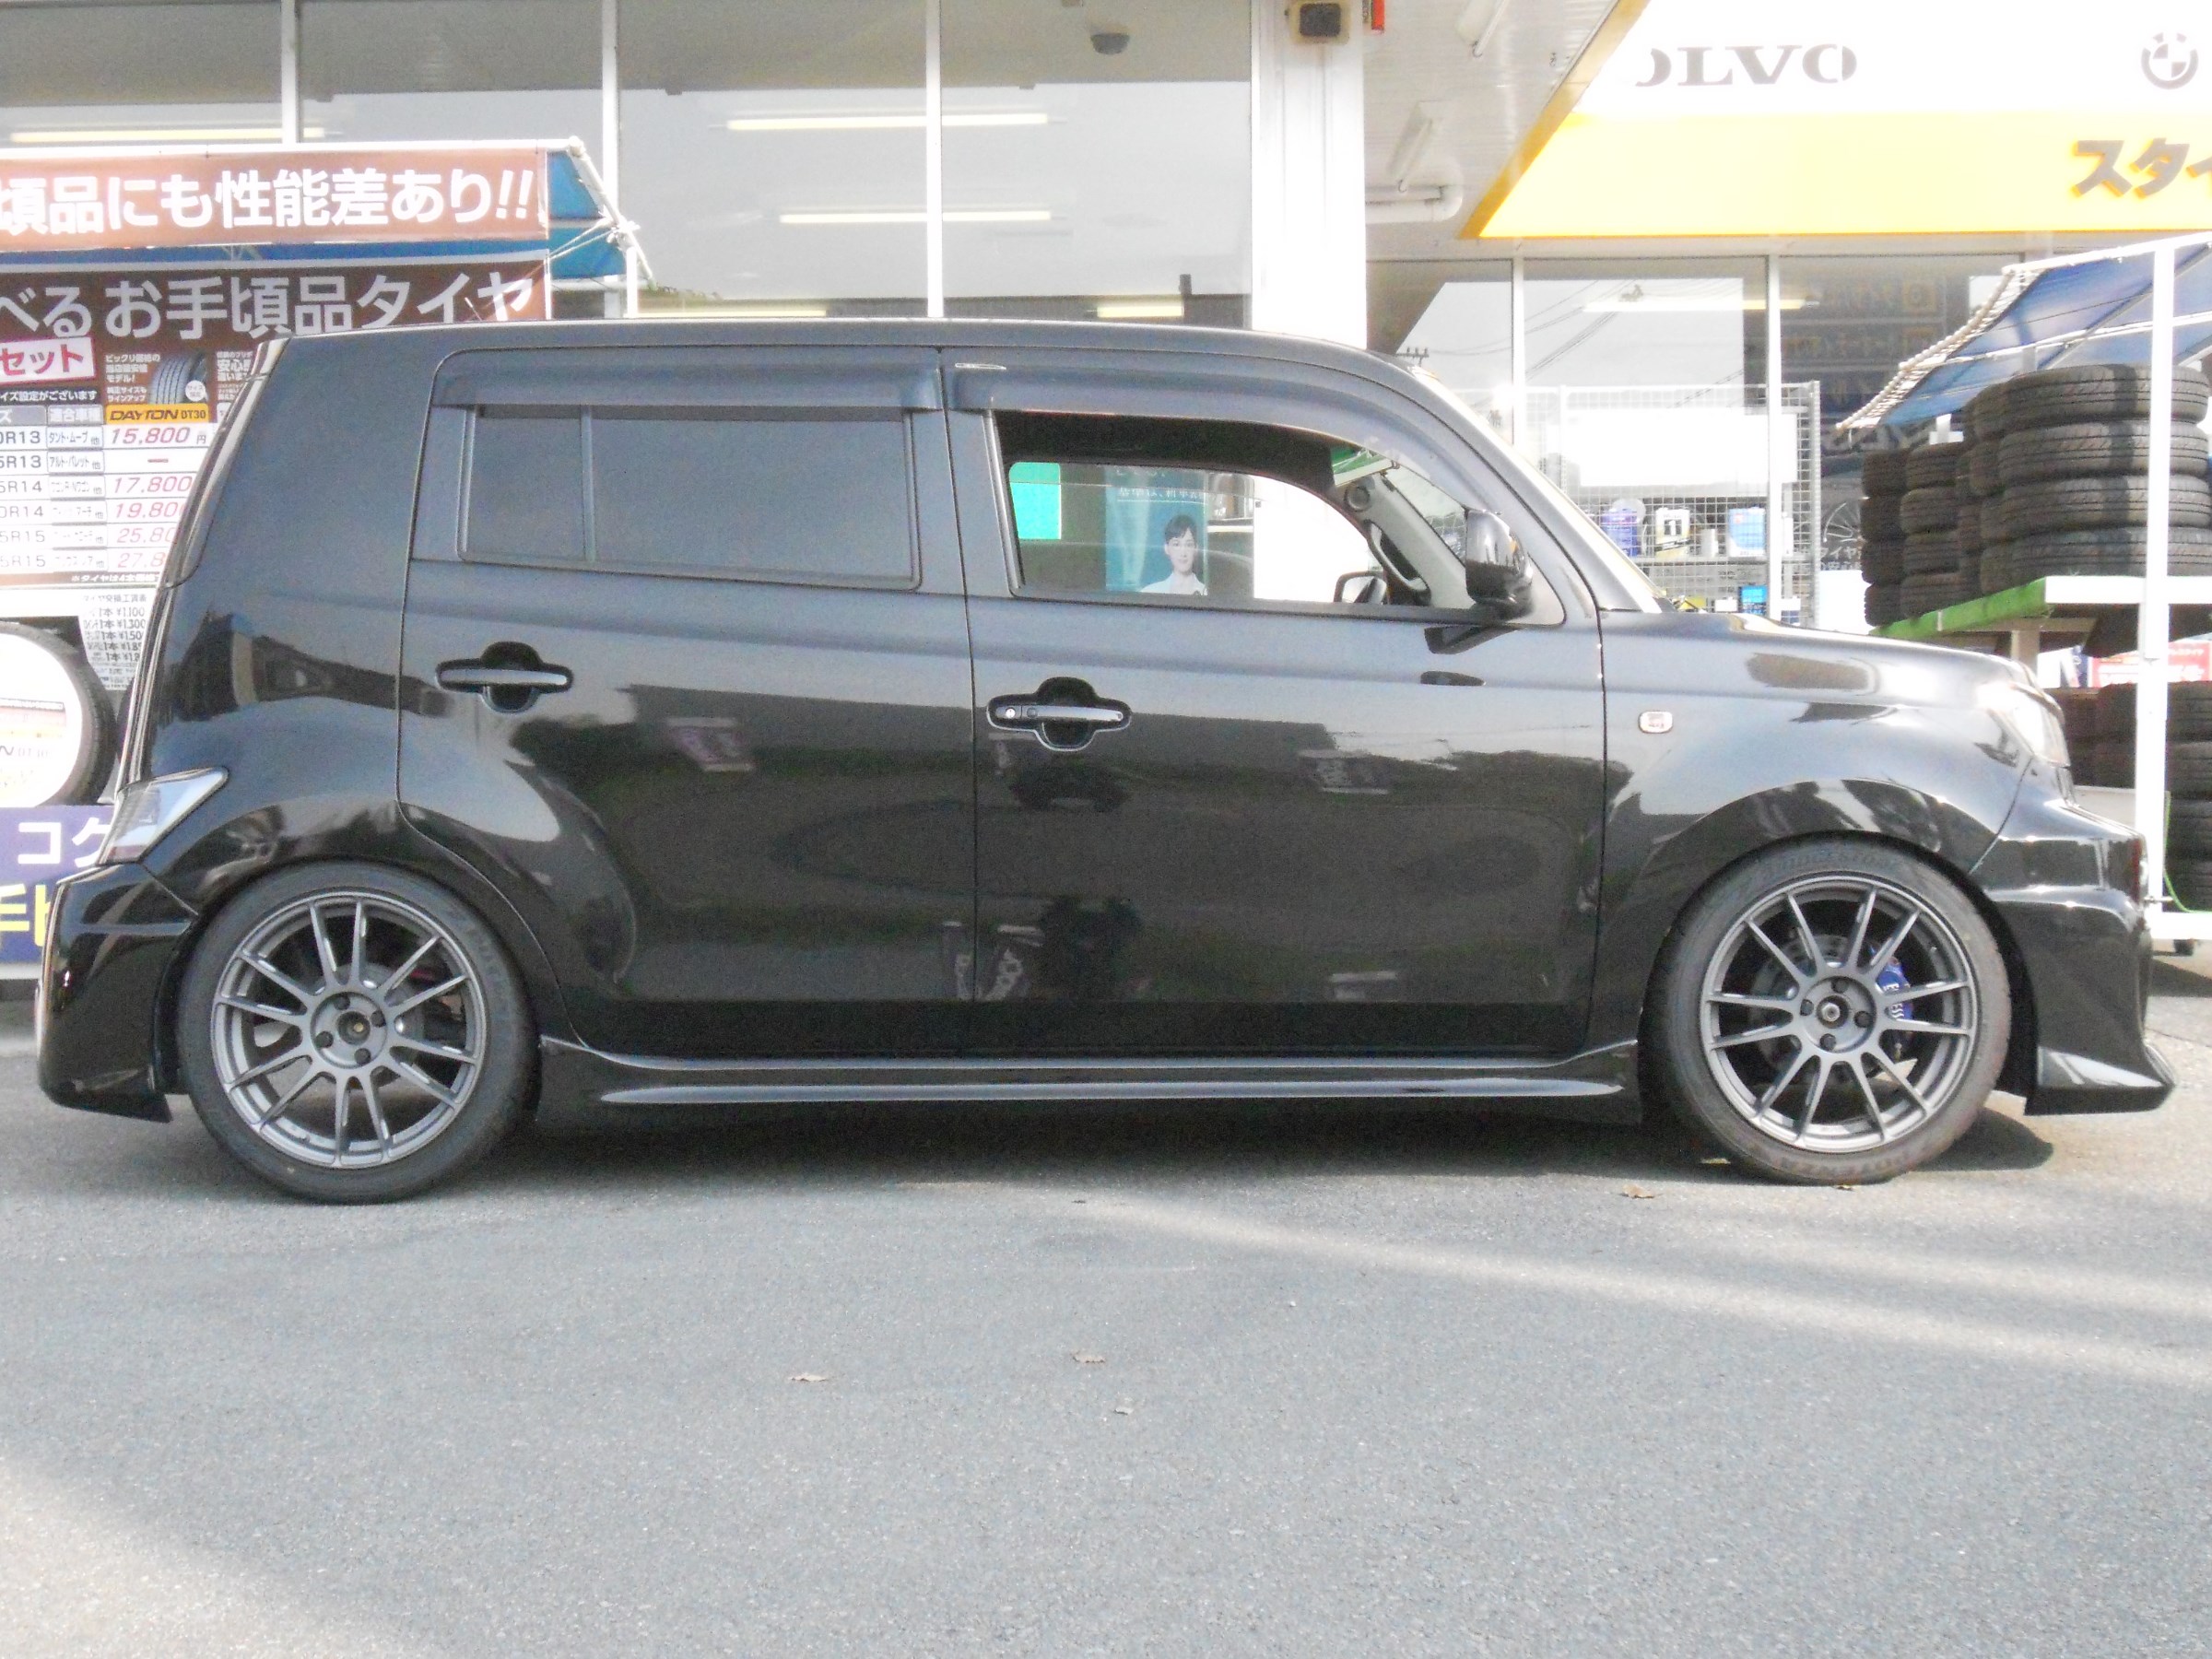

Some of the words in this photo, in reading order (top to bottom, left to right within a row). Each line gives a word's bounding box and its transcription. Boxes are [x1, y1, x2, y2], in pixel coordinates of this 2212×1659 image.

[0, 344, 84, 376] セット
[110, 409, 179, 421] DAYTON
[181, 409, 206, 419] DT30
